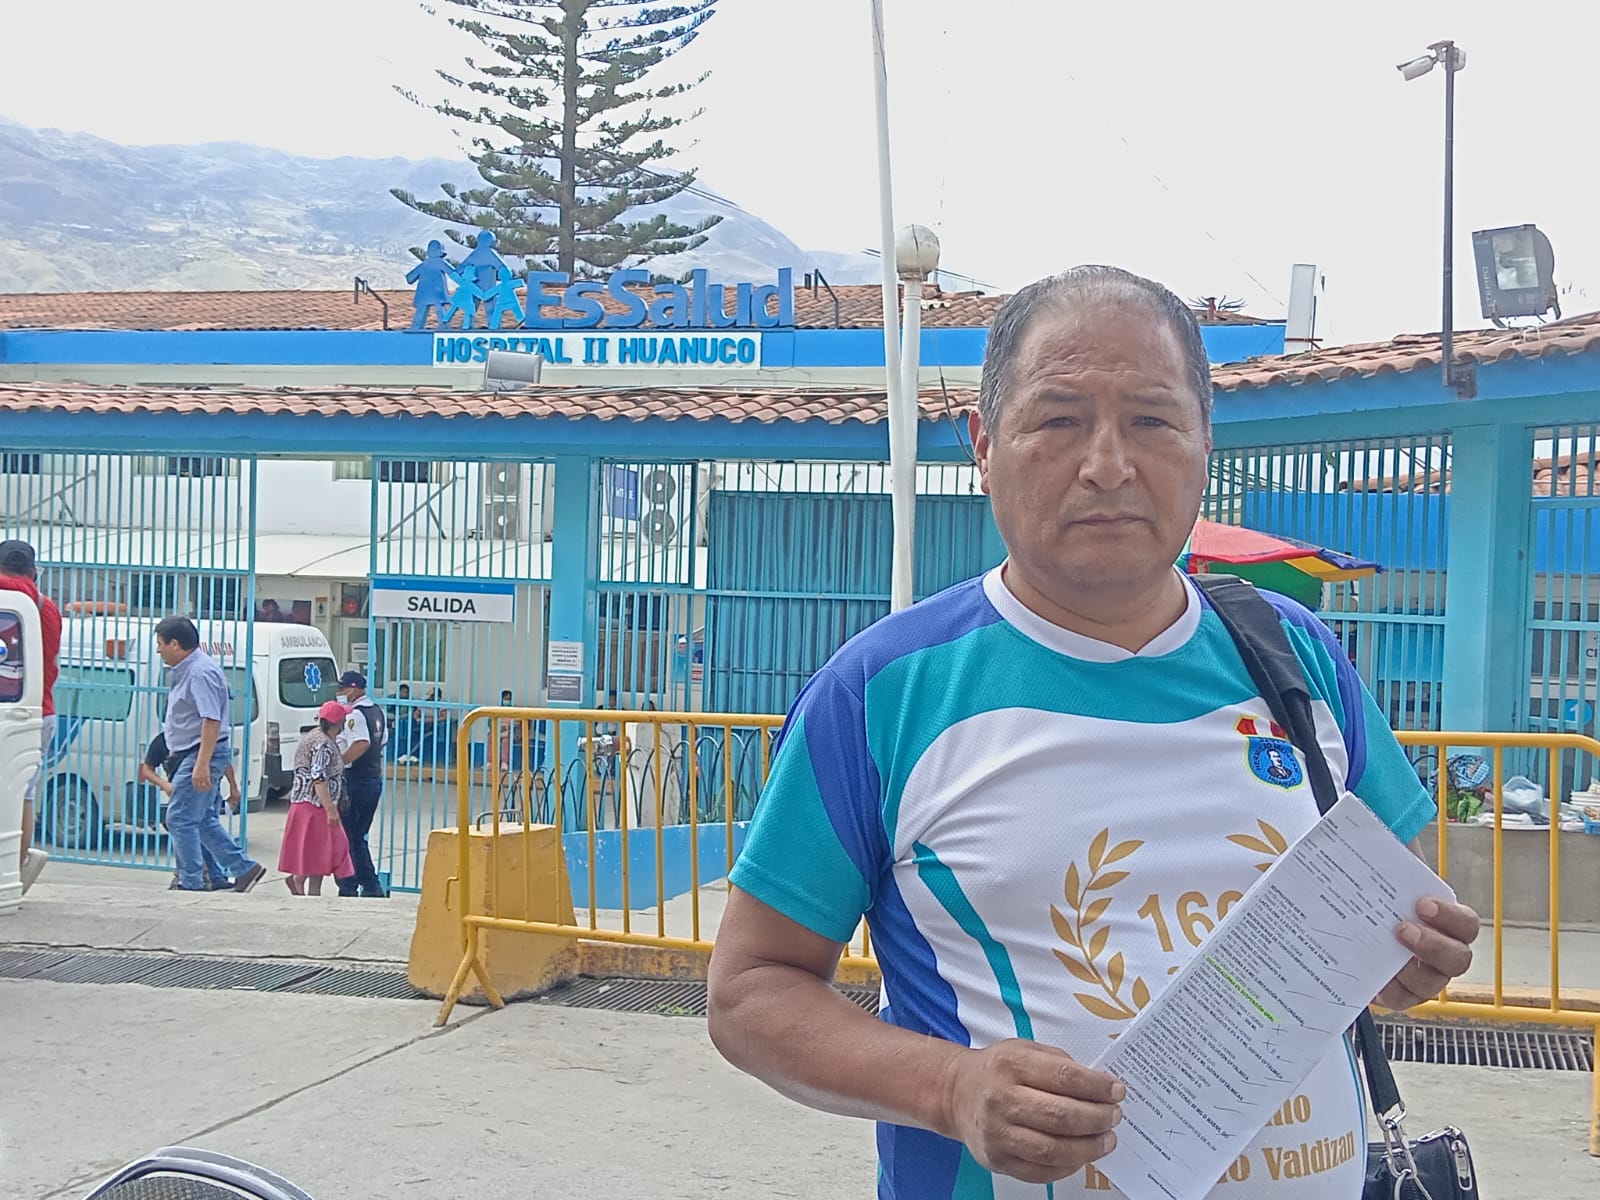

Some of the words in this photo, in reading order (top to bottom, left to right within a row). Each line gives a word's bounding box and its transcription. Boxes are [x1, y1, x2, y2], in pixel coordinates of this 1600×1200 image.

[525, 267, 794, 329] EsSalud
[583, 337, 609, 364] II
[618, 338, 756, 364] HUANUCO
[407, 596, 477, 615] SALIDA
[1262, 1131, 1356, 1181] Valdizan
